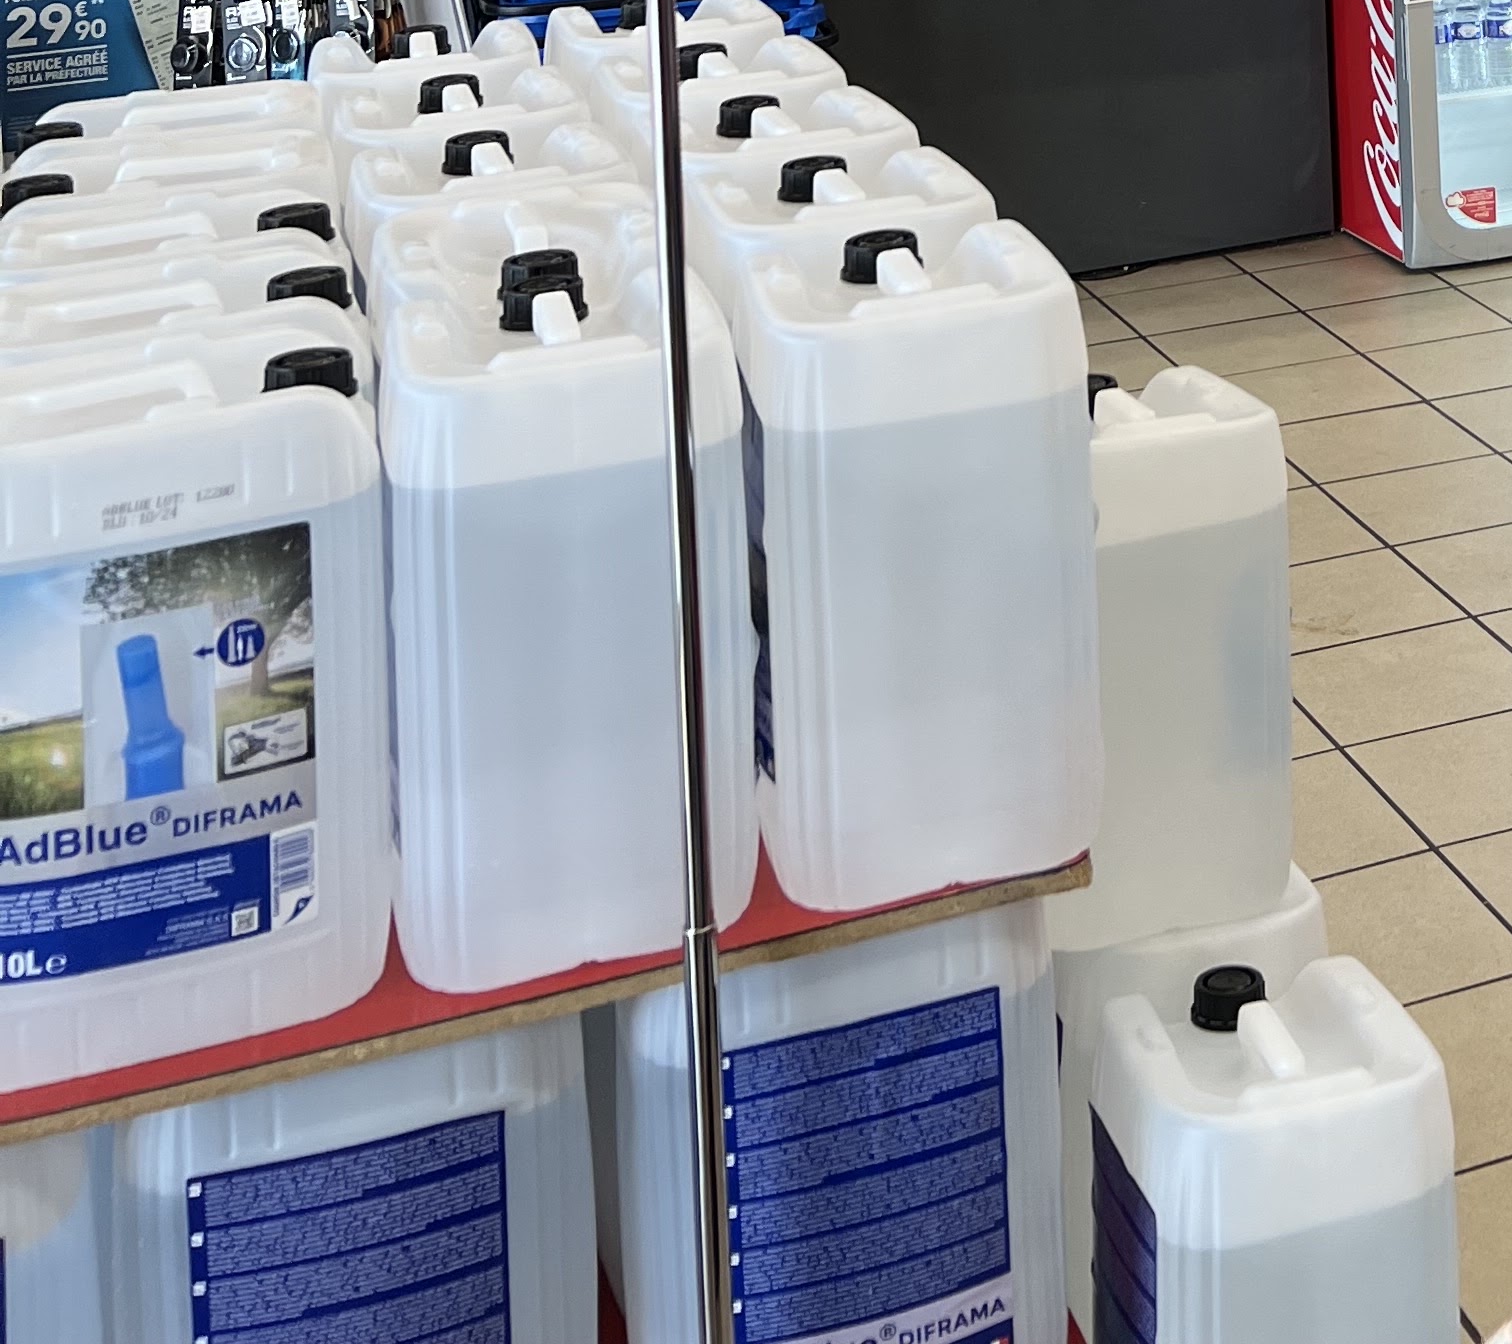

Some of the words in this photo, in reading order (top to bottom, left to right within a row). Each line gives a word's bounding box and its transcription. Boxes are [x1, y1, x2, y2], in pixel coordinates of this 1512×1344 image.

[7, 3, 72, 48] 29
[7, 55, 62, 75] SERVICE
[67, 50, 108, 67] AGRÉÉ
[7, 75, 27, 85] PAR
[30, 73, 43, 82] LA
[46, 64, 108, 81] PRÉFECTURE
[173, 791, 303, 838] DIFRAMA
[900, 1297, 1005, 1344] DIFRAMA
